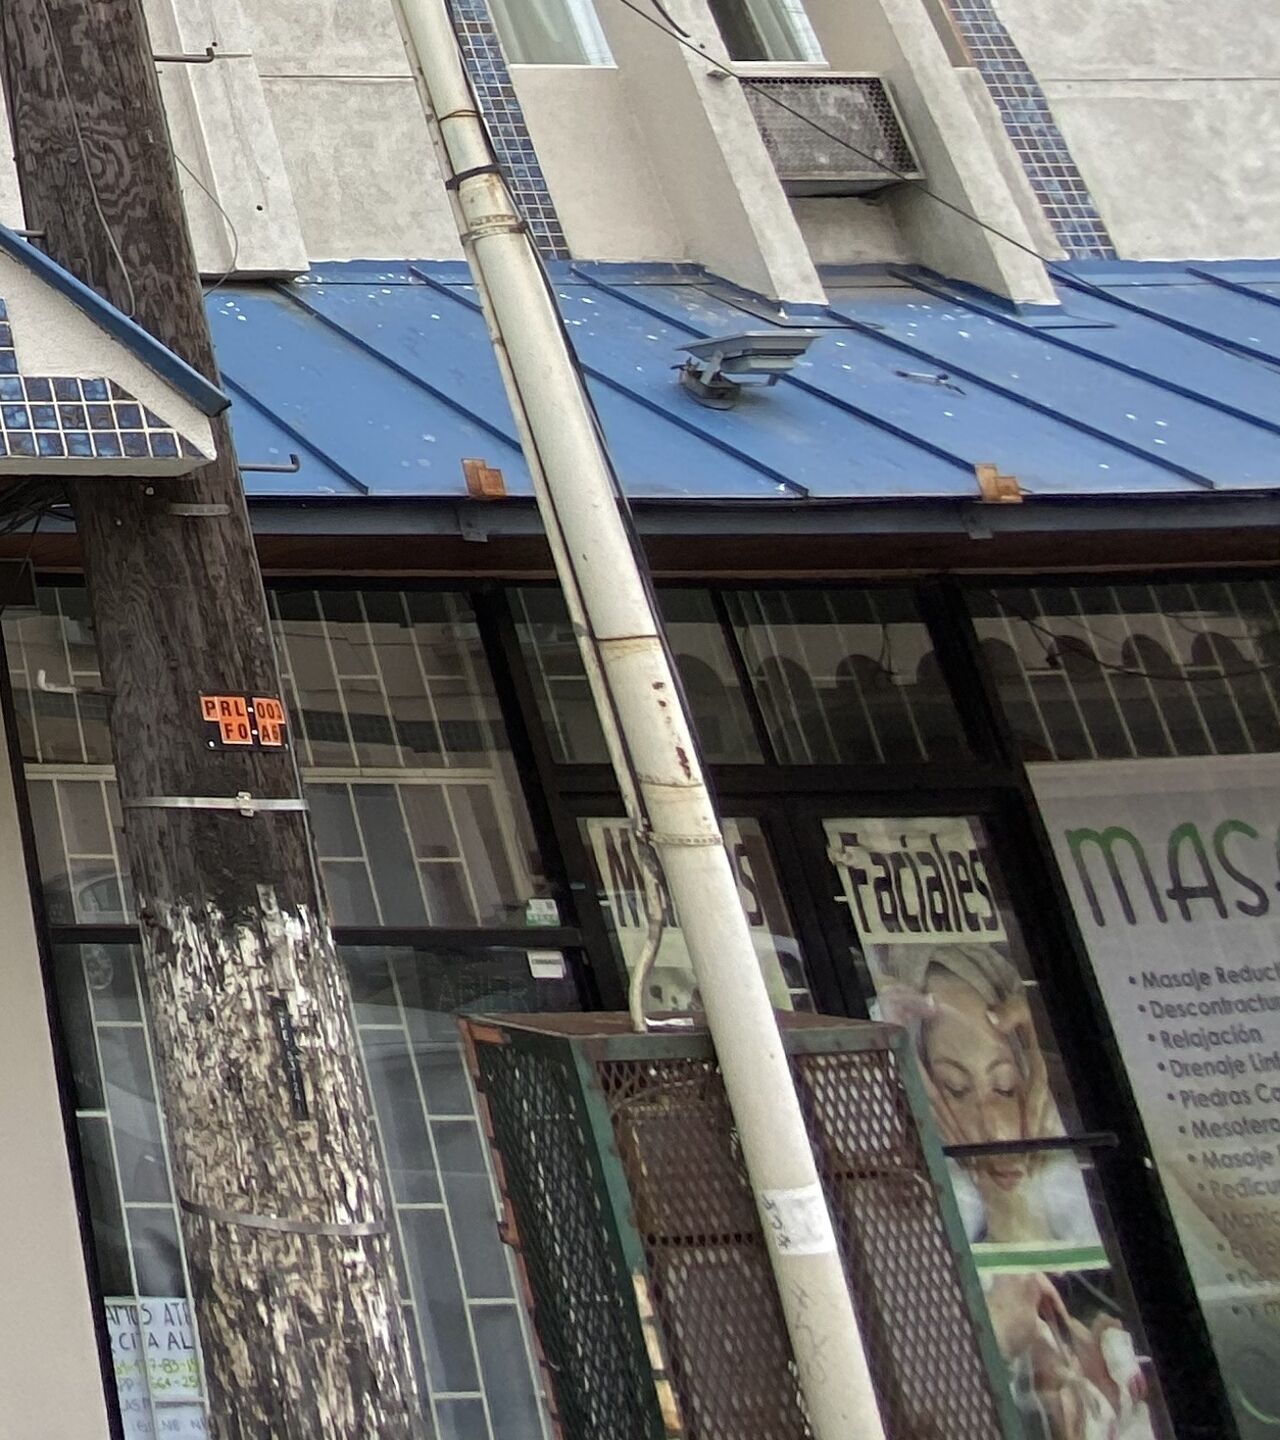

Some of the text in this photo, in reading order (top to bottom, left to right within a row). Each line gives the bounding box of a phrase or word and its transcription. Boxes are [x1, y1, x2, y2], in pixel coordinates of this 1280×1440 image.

[839, 832, 999, 933] Faciales
[1064, 818, 1280, 927] MAS
[1141, 968, 1211, 991] Masaje
[1160, 1023, 1264, 1051] Relajación
[1169, 1054, 1246, 1079] Drenaje
[1180, 1087, 1252, 1109] Piedras
[1202, 1146, 1274, 1171] Masaje
